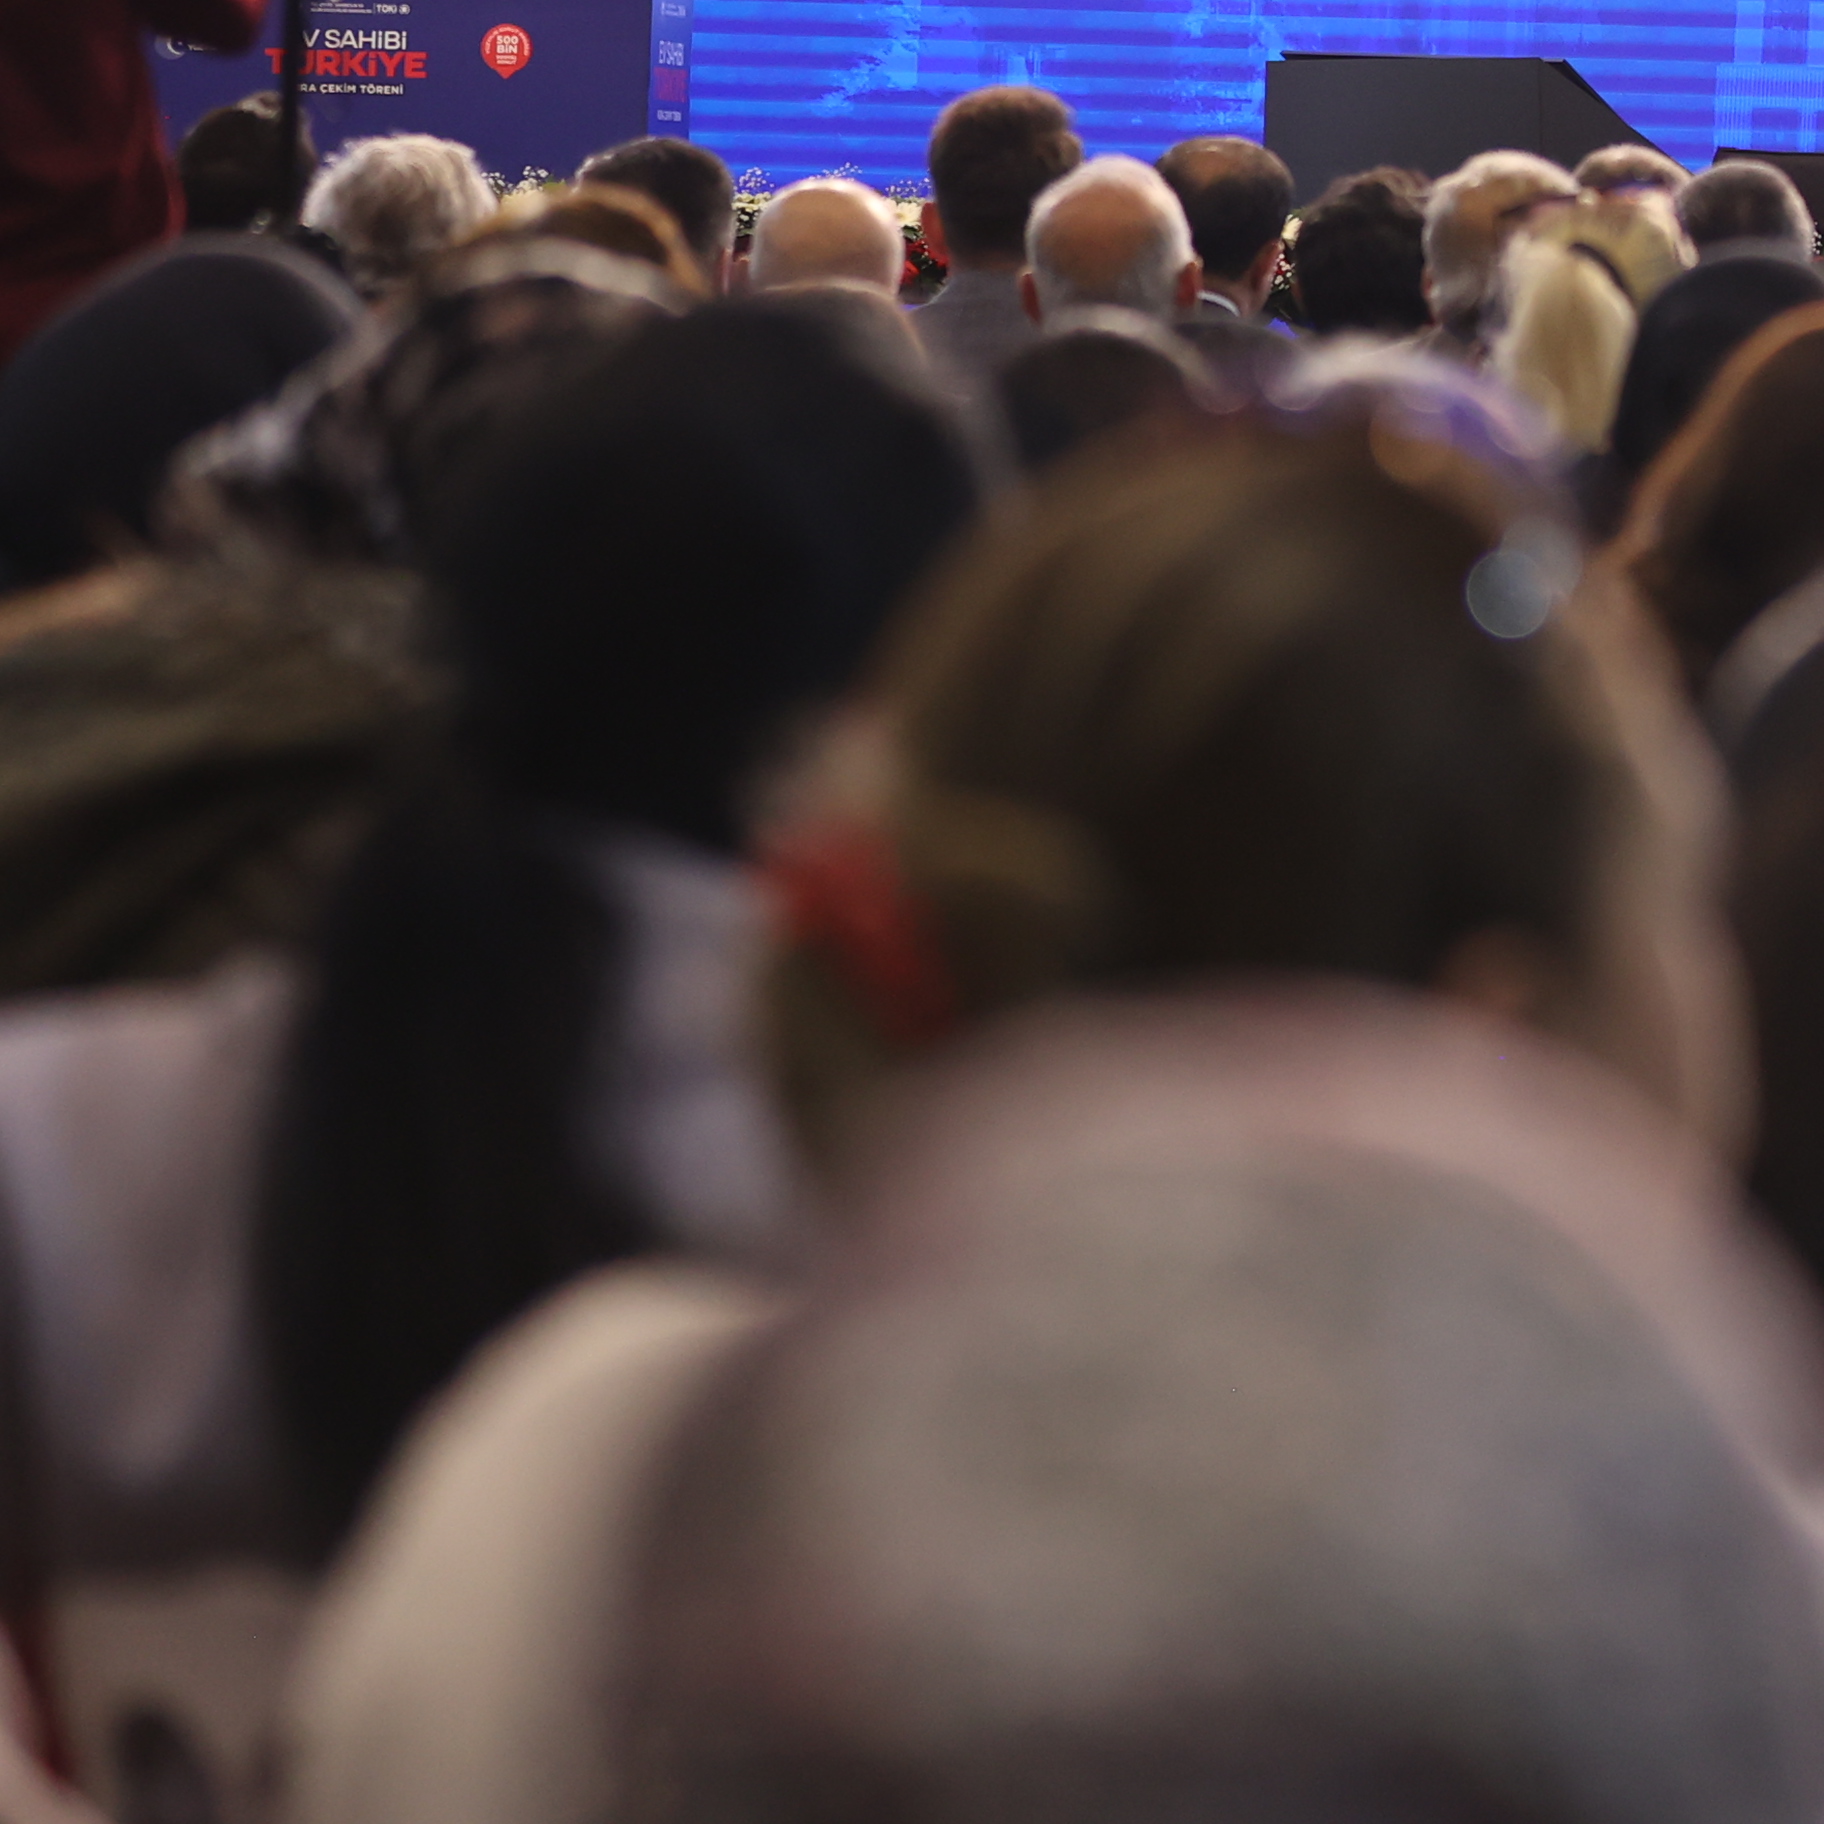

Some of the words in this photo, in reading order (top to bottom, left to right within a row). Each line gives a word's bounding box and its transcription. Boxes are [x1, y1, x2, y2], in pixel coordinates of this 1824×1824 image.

[496, 35, 519, 45] 500
[320, 82, 357, 94] ÇEKİM
[360, 84, 404, 95] TÖRENİ
